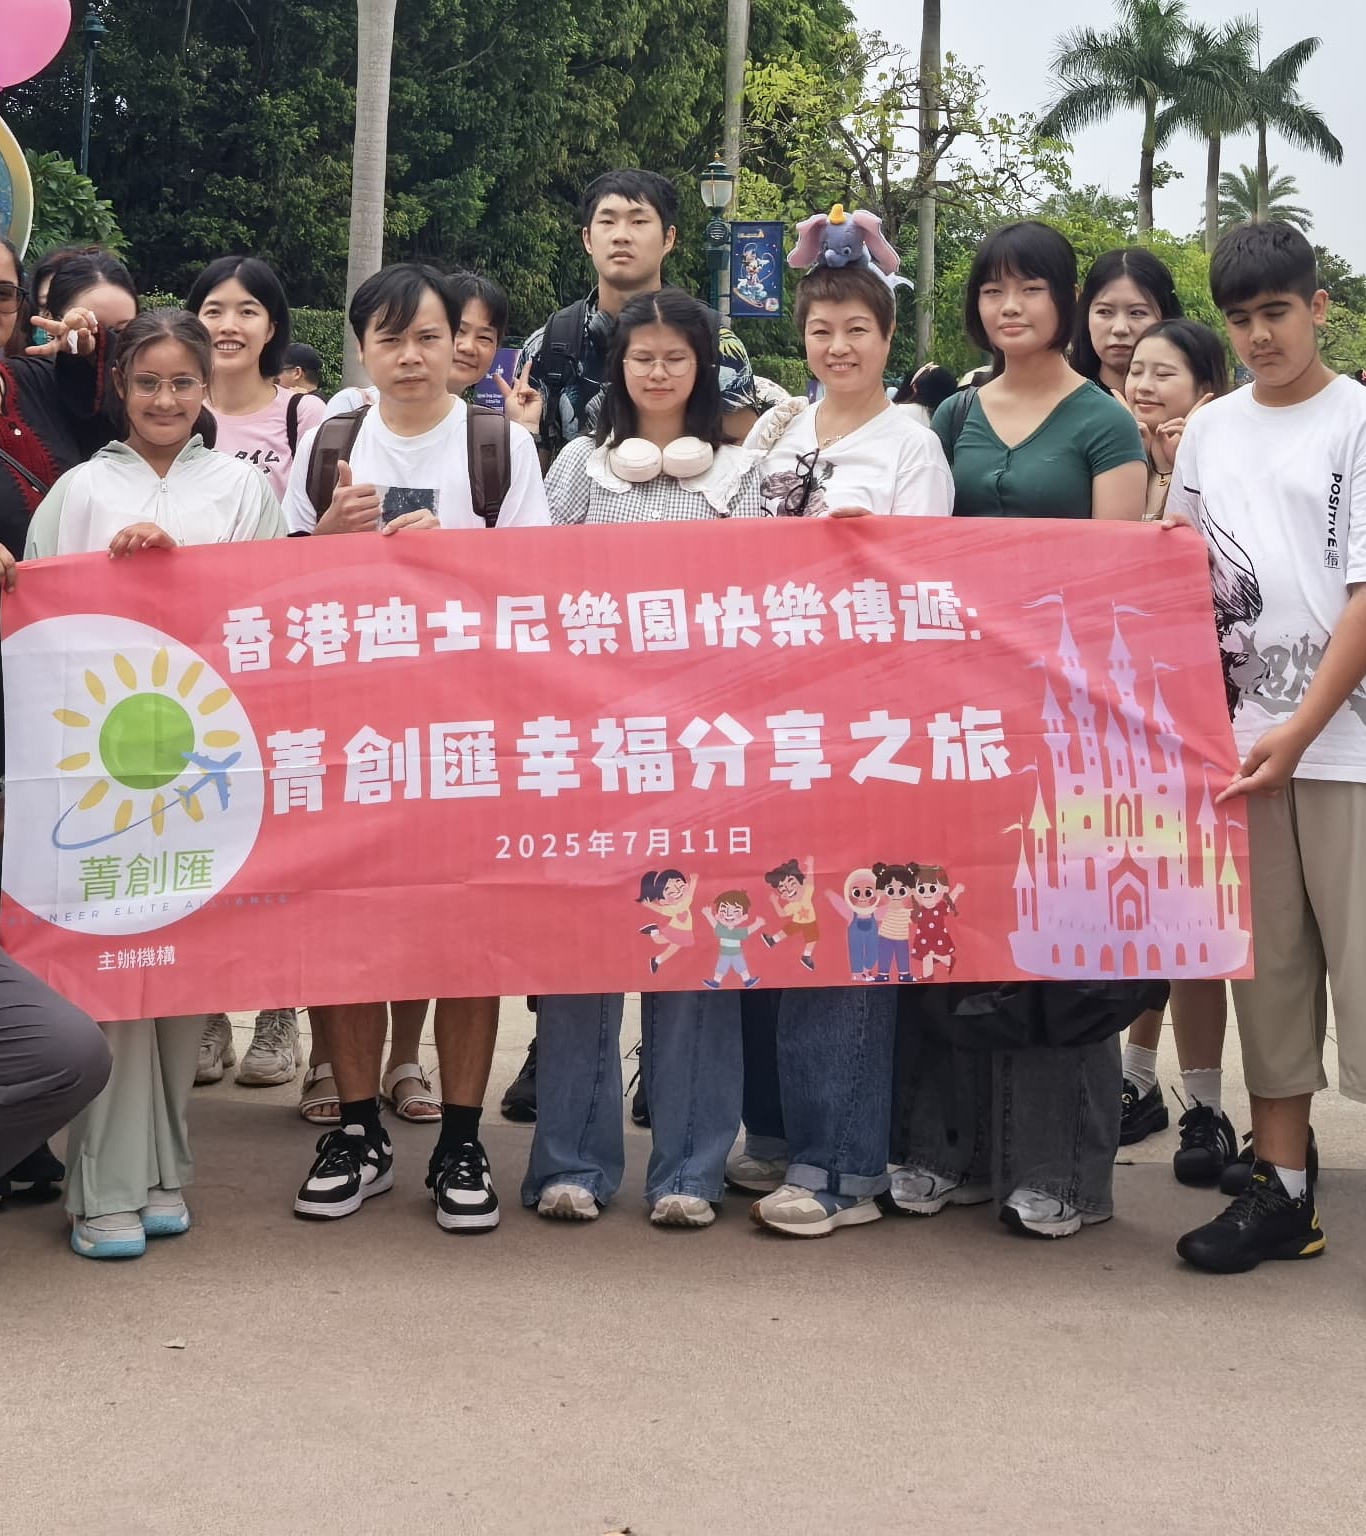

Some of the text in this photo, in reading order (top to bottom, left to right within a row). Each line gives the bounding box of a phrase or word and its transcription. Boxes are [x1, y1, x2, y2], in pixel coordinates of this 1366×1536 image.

[1327, 472, 1343, 549] POSITIVE
[266, 705, 1012, 815] 菁創匯幸福分享之旅
[495, 826, 751, 859] 2025年7月11日
[78, 849, 215, 902] 菁創匯
[114, 902, 171, 916] ELITE
[97, 944, 176, 971] 主辦機構
